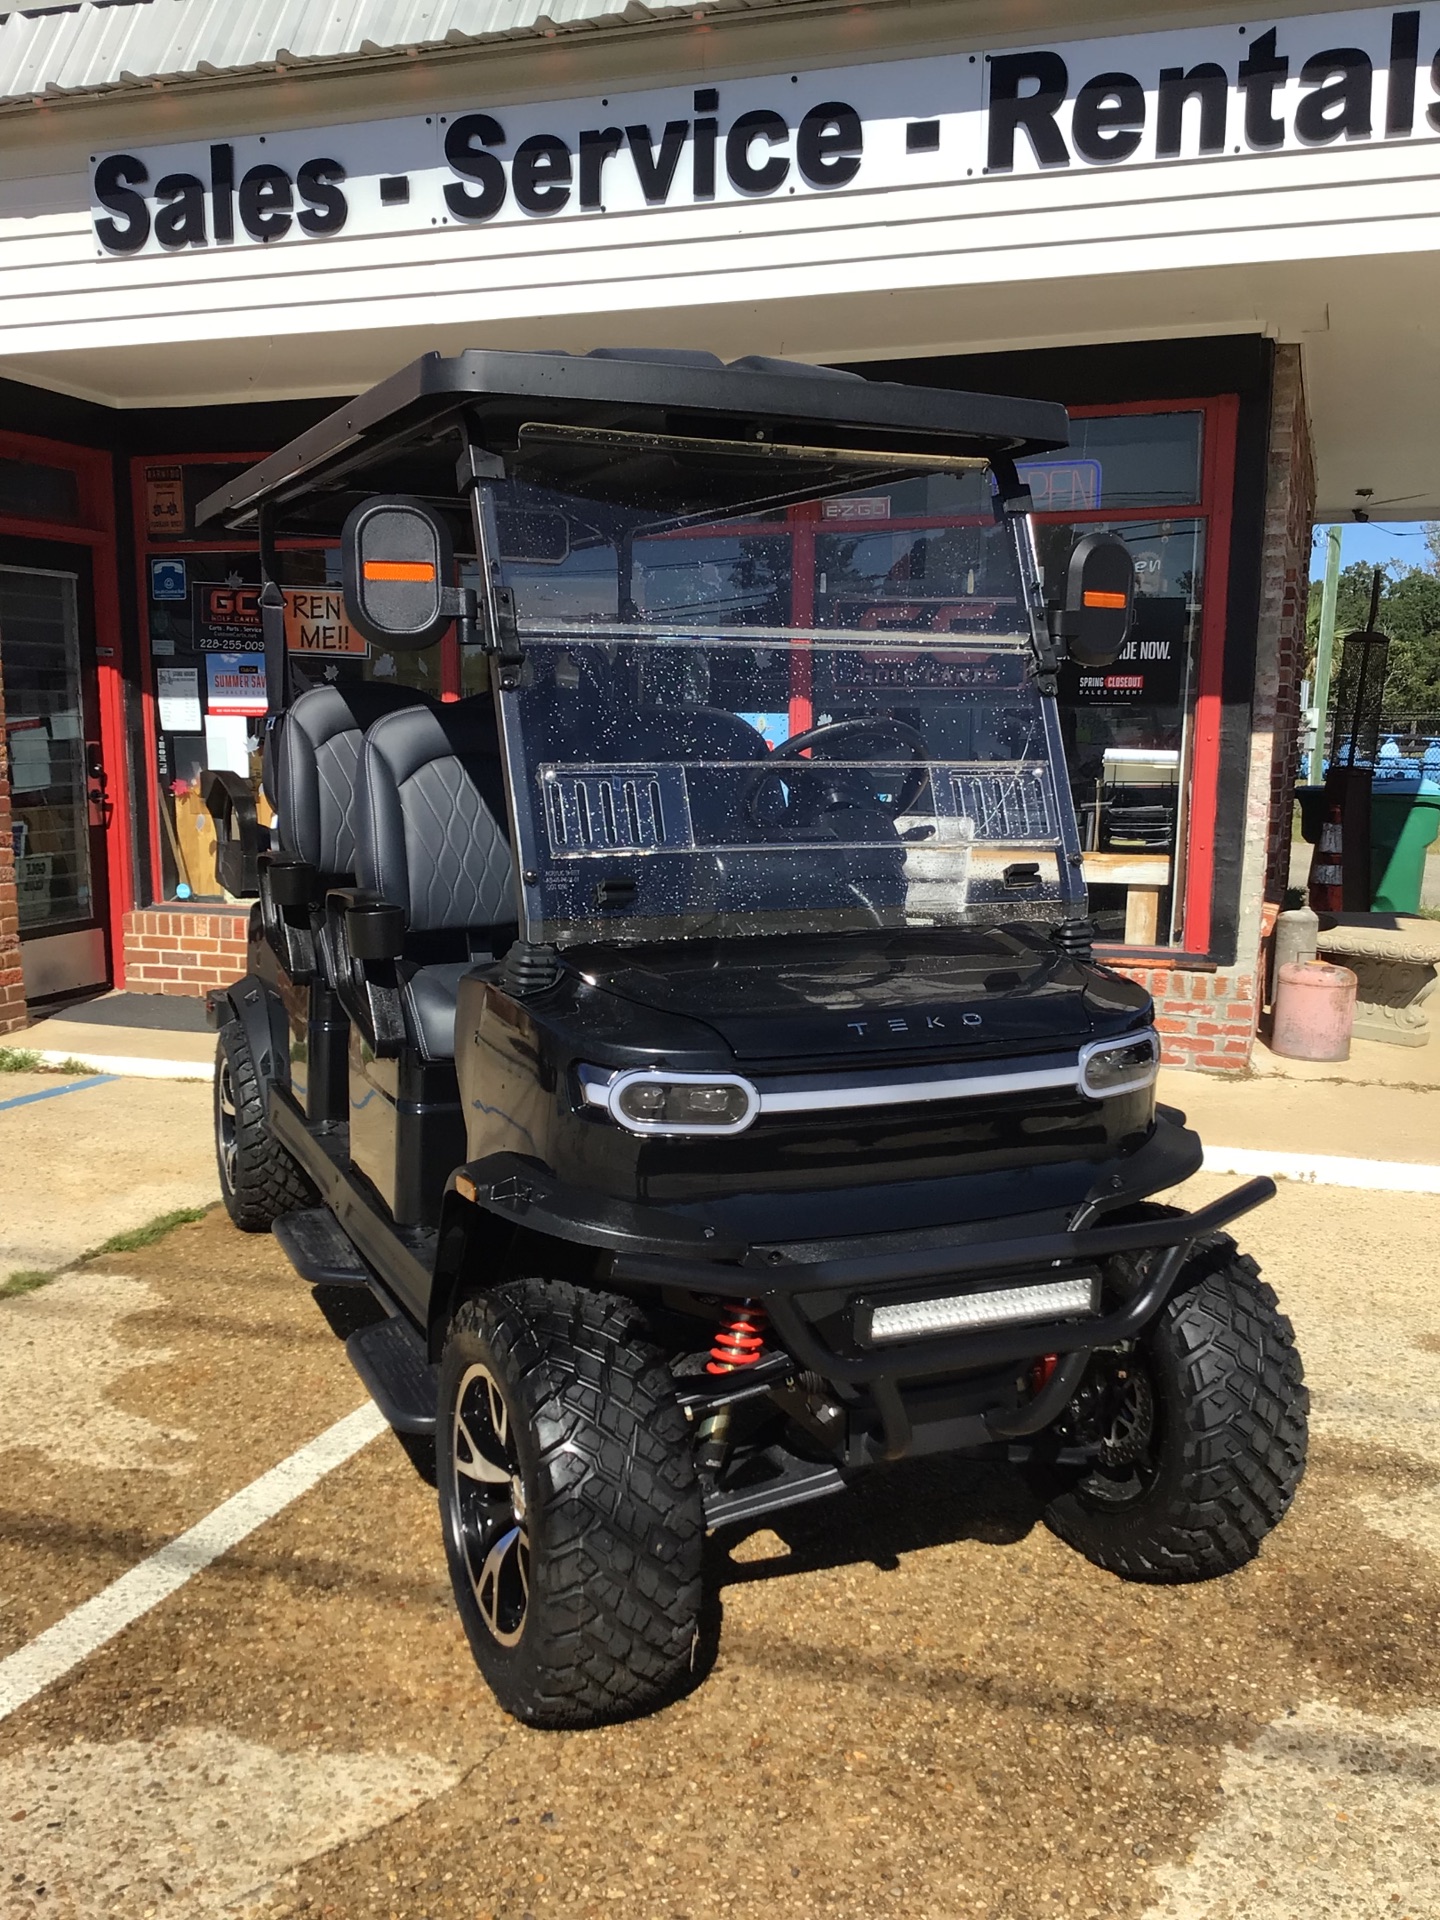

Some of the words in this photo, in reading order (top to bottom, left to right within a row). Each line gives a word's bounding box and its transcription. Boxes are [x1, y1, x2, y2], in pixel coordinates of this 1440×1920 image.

[94, 143, 349, 255] Sales
[442, 88, 864, 221] Service
[987, 10, 1440, 174] Rental
[1017, 469, 1094, 512] PEN
[210, 589, 258, 615] GC
[293, 594, 344, 620] REN
[300, 625, 349, 650] ME!!
[1139, 641, 1171, 660] NOW.
[214, 674, 249, 688] SUMMER
[1079, 676, 1104, 688] SPRING
[1107, 676, 1142, 688] CLOSEOUT
[847, 1013, 983, 1036] TEKO
